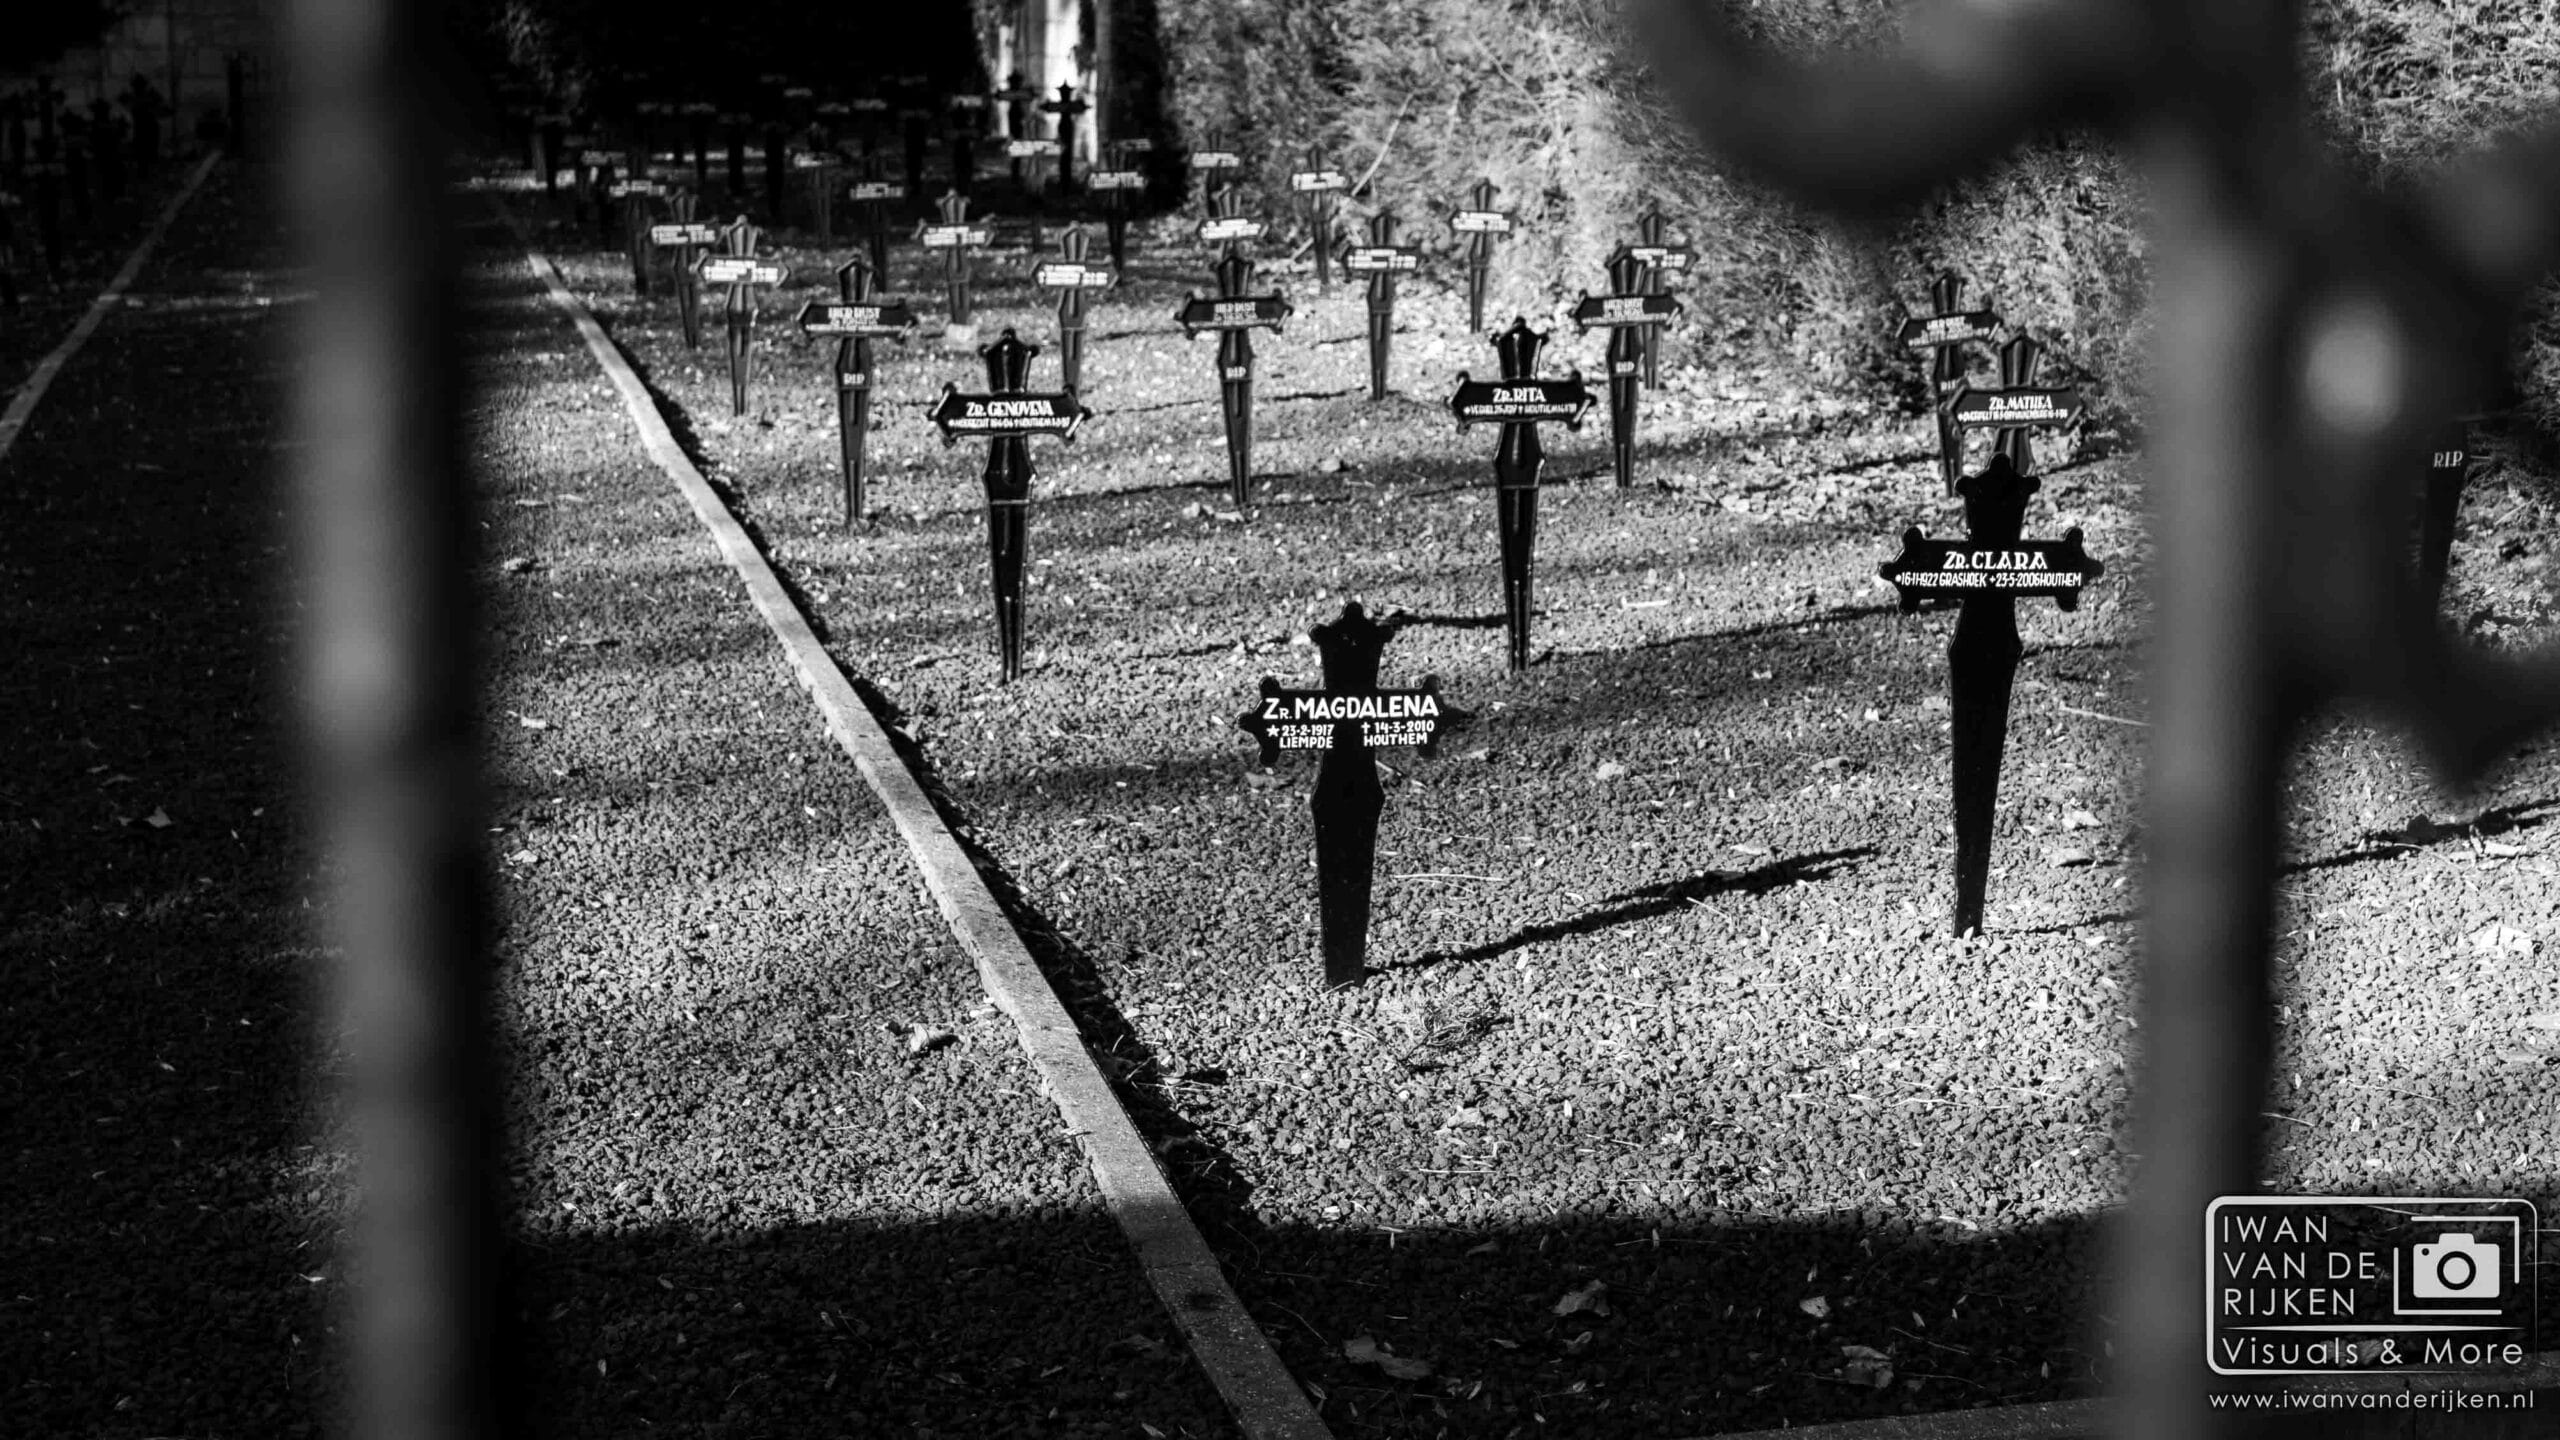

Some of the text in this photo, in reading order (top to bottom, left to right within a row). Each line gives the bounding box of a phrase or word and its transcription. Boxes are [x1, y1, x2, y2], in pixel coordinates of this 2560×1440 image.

[1513, 387, 1547, 402] RITA
[987, 400, 1054, 417] GENOVEVA
[1971, 551, 2048, 570] CLARA
[1939, 572, 1988, 588] GRASHOEK
[2040, 572, 2082, 587] HOUTHEM
[1294, 695, 1440, 720] MAGDALENA
[1281, 724, 1335, 737] 23-2-1917
[1374, 720, 1435, 734] 14-3-2010
[1279, 736, 1334, 749] LIEMPDE
[1363, 732, 1428, 747] HOUTHEM
